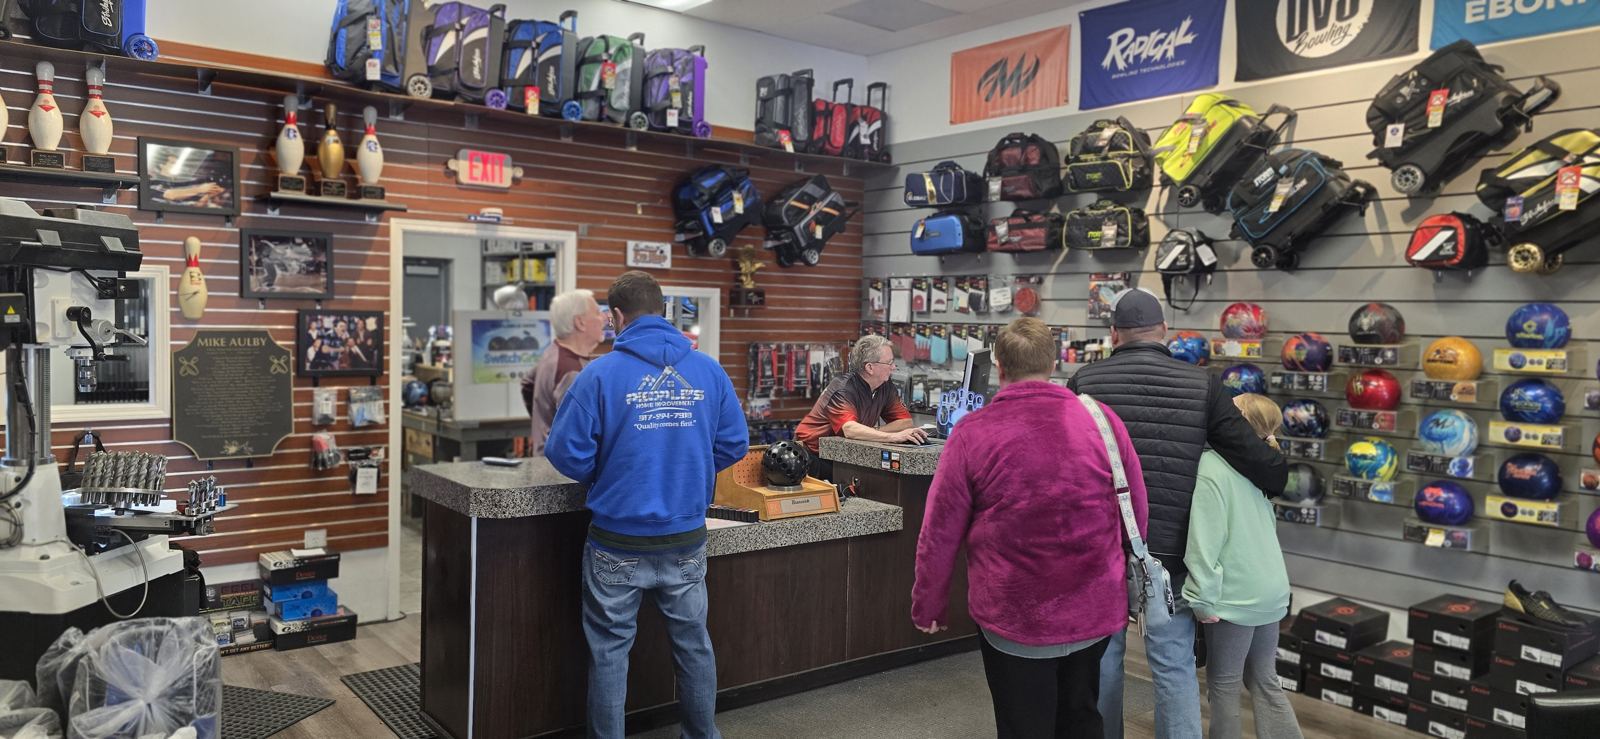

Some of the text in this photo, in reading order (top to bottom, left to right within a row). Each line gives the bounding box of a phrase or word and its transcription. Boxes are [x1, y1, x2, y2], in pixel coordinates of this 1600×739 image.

[1101, 14, 1199, 71] RADICAL
[1295, 22, 1352, 55] Bowling
[468, 151, 506, 183] EXIT
[197, 338, 267, 347] MIKE AULBY
